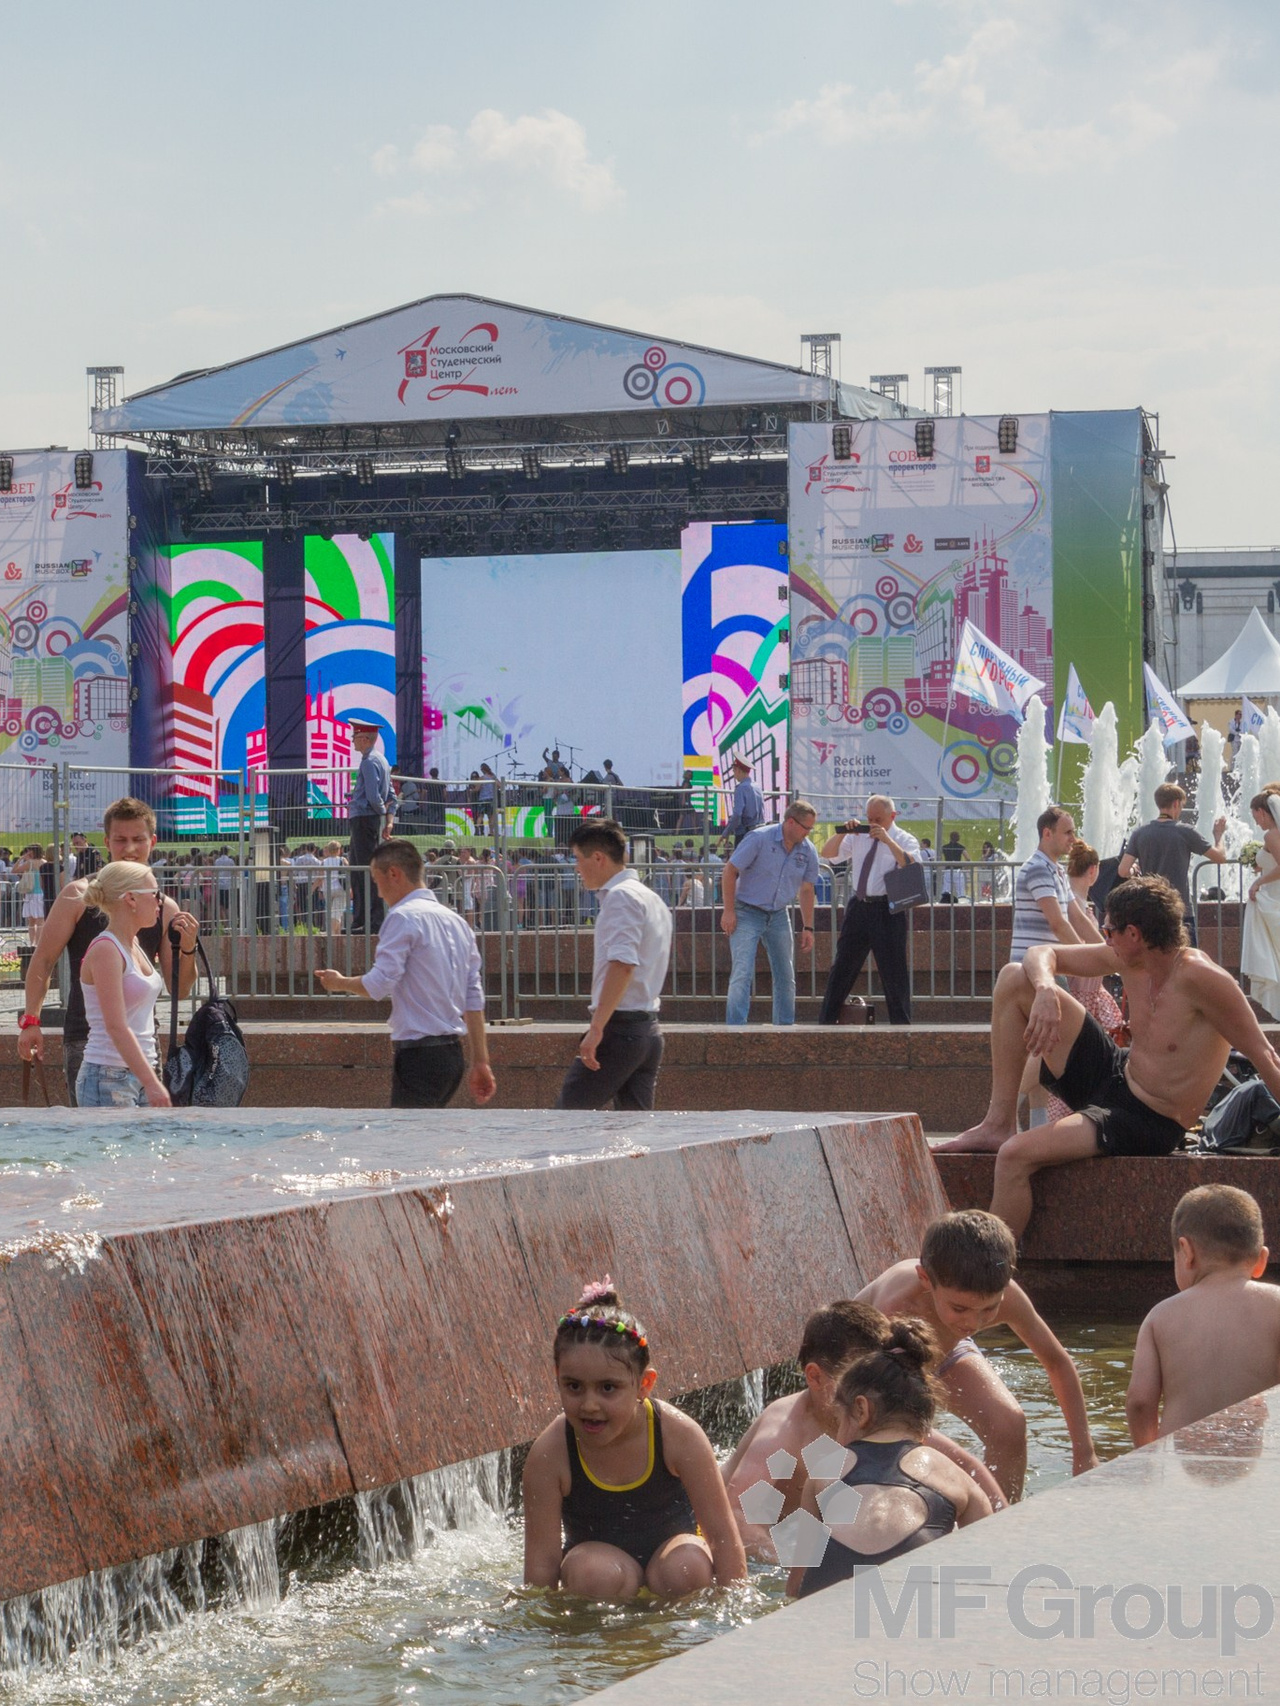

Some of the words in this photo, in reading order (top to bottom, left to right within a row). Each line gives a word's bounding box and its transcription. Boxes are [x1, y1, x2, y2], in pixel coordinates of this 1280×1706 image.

[429, 343, 494, 355] Московский
[430, 355, 502, 368] Студенческий
[430, 370, 462, 380] Центр
[888, 462, 937, 476] проректоров
[833, 755, 877, 767] Reckitt
[833, 766, 893, 778] Benckiser
